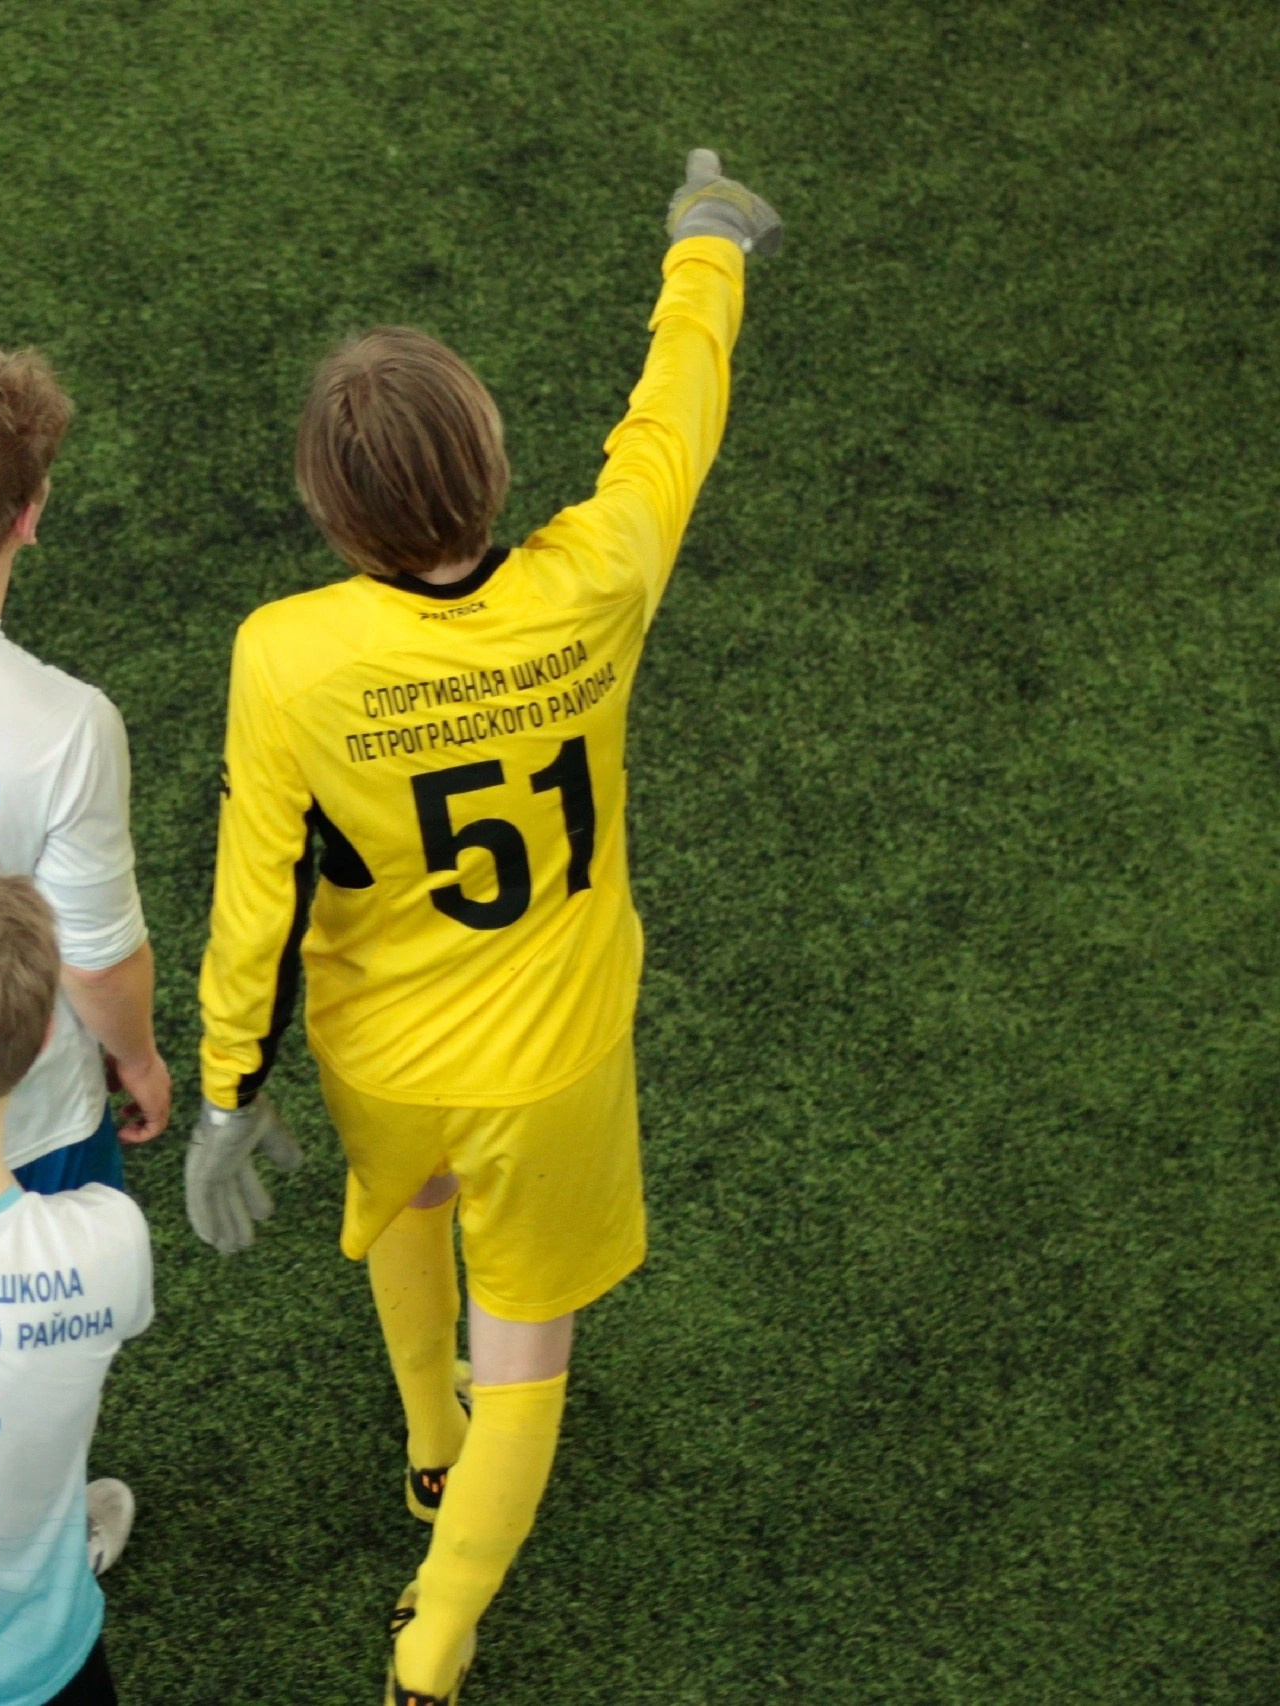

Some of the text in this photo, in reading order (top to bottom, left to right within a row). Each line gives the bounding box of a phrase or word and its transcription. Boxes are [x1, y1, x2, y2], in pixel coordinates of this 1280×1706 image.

[430, 600, 488, 622] PATRICK
[345, 661, 617, 763] ПЕТРОГРАДСКОГО РАЙОНА
[362, 640, 588, 719] СПОРТИВНАЯ ШКОЛА
[410, 735, 596, 931] 51
[17, 1307, 113, 1350] РАЙОНА
